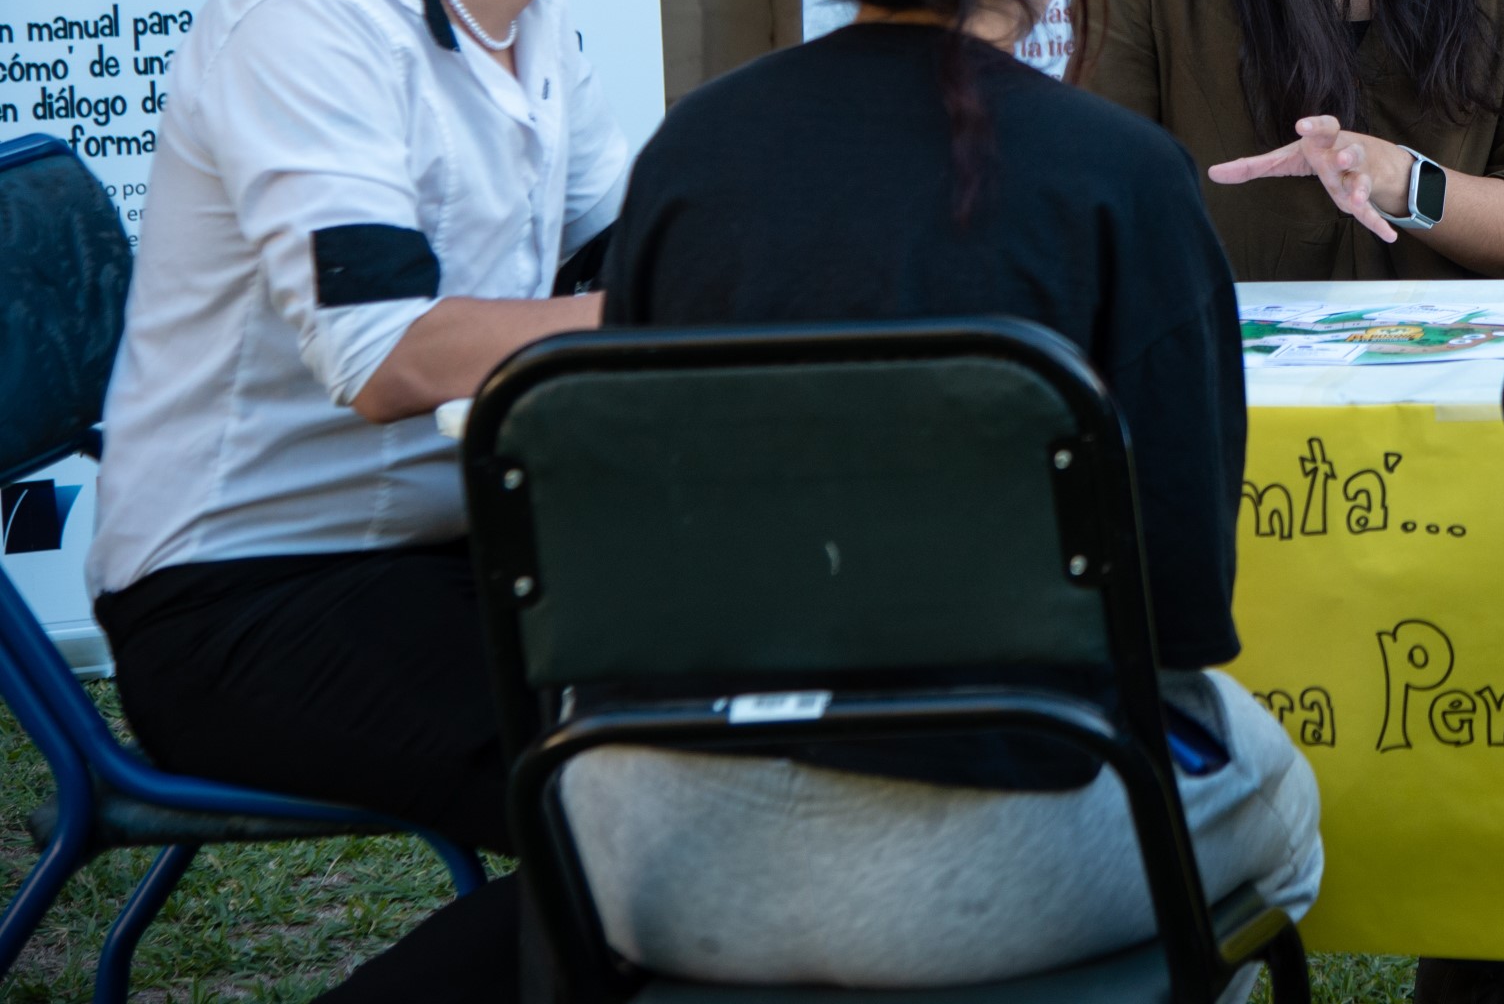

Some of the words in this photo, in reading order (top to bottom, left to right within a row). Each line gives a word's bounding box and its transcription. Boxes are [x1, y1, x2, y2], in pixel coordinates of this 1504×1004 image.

[27, 4, 120, 42] manual
[133, 10, 193, 52] para
[89, 44, 120, 77] de
[32, 85, 127, 126] diálogo
